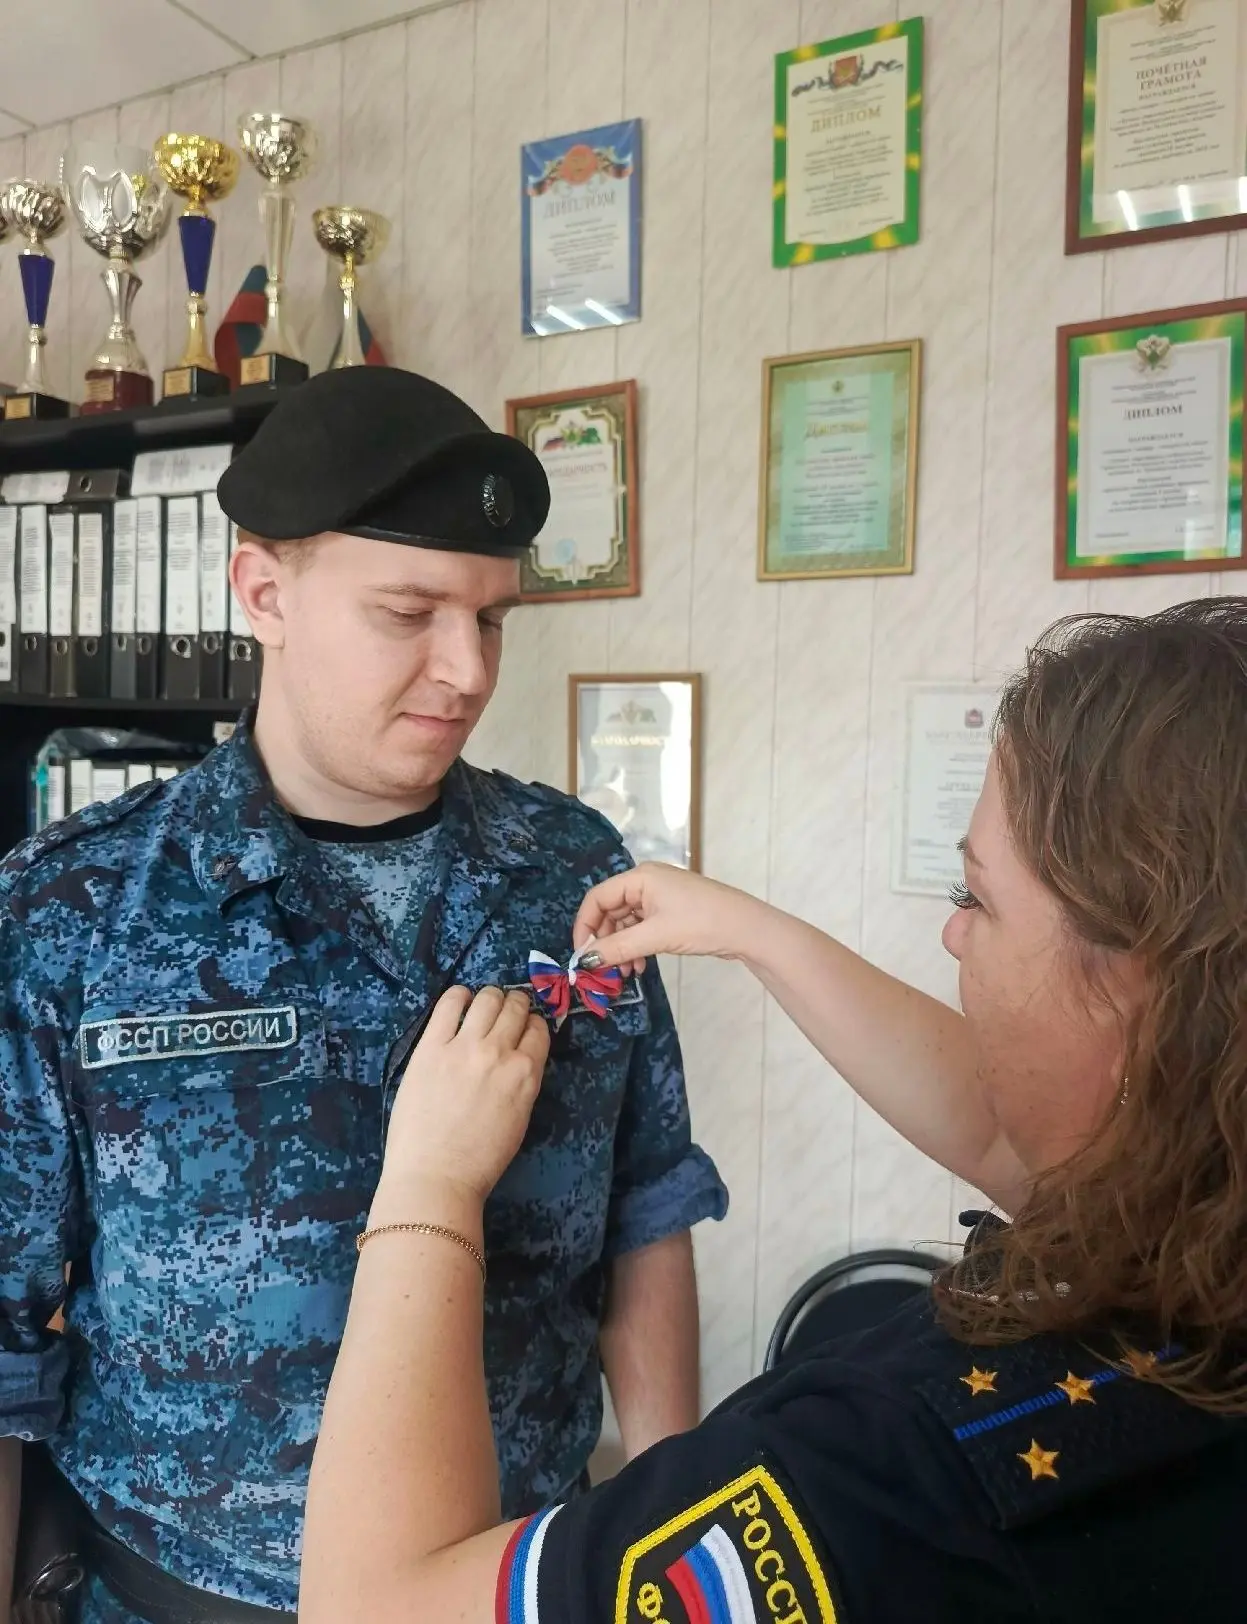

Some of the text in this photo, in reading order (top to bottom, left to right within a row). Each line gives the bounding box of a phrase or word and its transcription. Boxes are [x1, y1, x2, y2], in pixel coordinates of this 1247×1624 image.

[1140, 70, 1202, 91] ГРАМОТА
[97, 1017, 281, 1051] ФССП РОССИИ
